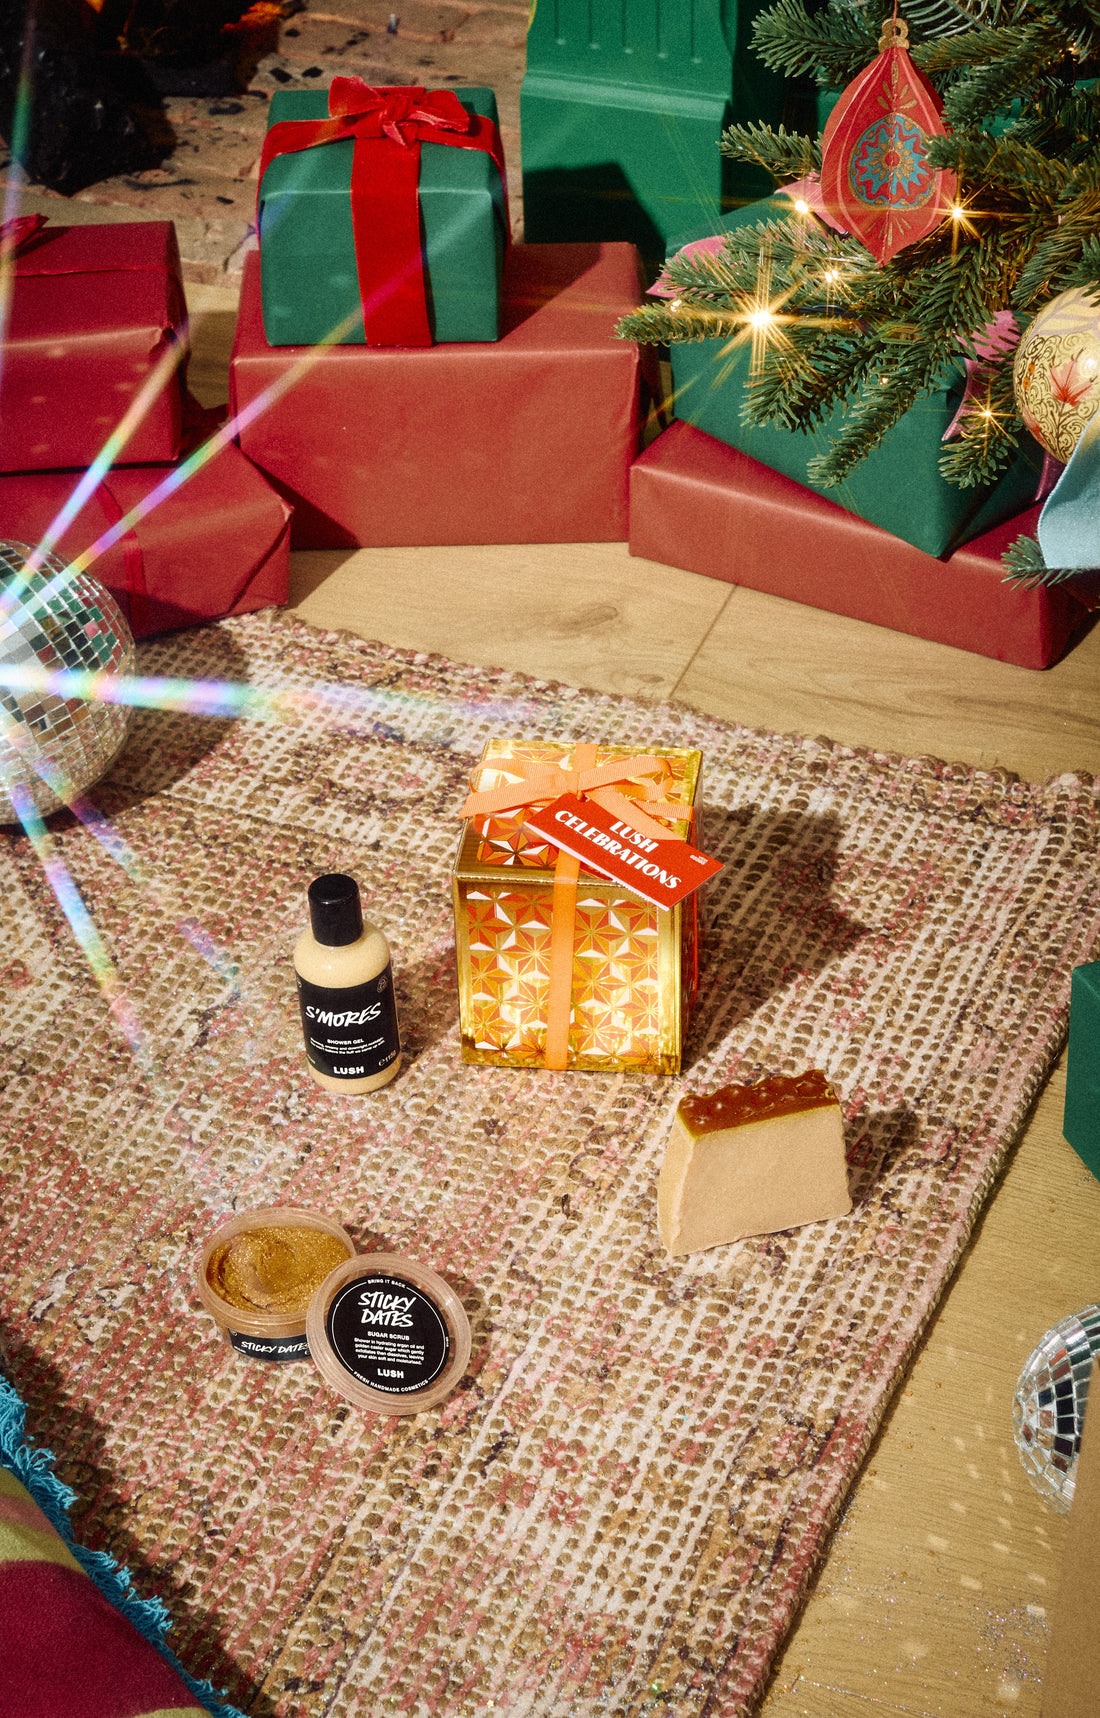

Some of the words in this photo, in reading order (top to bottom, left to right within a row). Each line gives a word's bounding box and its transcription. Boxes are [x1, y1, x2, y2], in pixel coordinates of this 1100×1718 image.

[609, 820, 660, 854] LUSH
[554, 810, 682, 889] CELEBRATIONS
[305, 1002, 382, 1027] S'MORES
[333, 1066, 365, 1075] LUSH
[391, 1280, 406, 1289] BACK
[358, 1291, 417, 1312] STICKY
[360, 1308, 414, 1328] DATES
[367, 1331, 388, 1339] SUGAR
[241, 1341, 277, 1353] STICKY
[353, 1371, 369, 1384] FRESH
[369, 1381, 400, 1393] HANDMADE
[400, 1379, 429, 1392] COSMETICS
[377, 1368, 404, 1379] LUSH
